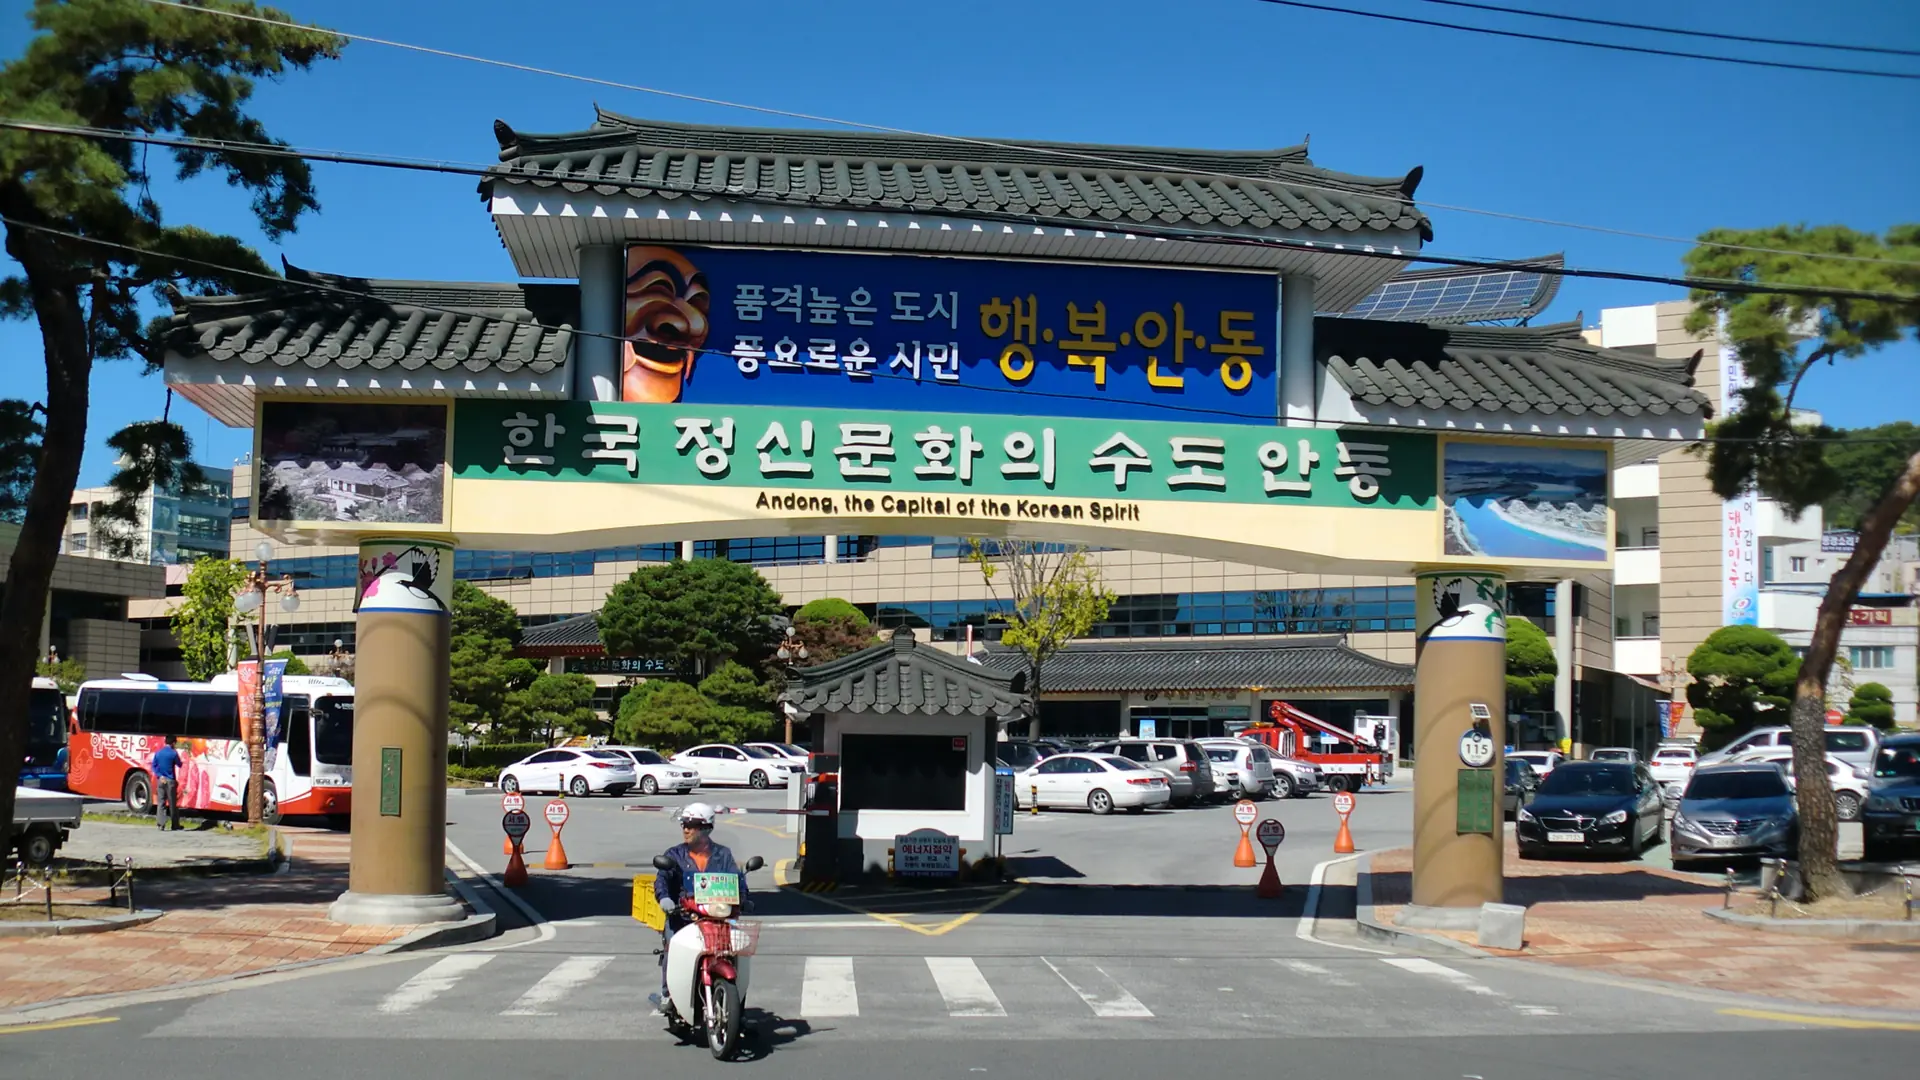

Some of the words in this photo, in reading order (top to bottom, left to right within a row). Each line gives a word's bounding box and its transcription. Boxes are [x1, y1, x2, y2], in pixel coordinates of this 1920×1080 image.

[733, 283, 877, 328] 품격높은
[890, 284, 959, 330] 도시
[733, 336, 877, 378] 풍요로운
[890, 340, 960, 382] 시민
[502, 412, 638, 473] 한국
[1089, 432, 1226, 486] 수도
[1257, 439, 1392, 499] 안동
[756, 491, 837, 514] Andong,
[845, 494, 875, 513] the
[880, 495, 950, 517] Capital
[956, 499, 975, 515] of
[981, 499, 1011, 517] the
[1016, 500, 1084, 519] Korean
[1089, 502, 1140, 523] Spirit
[645, 659, 665, 670] 수도
[91, 734, 150, 761] 안동한우
[1465, 743, 1488, 755] 115
[902, 844, 952, 855] 에너지절약
